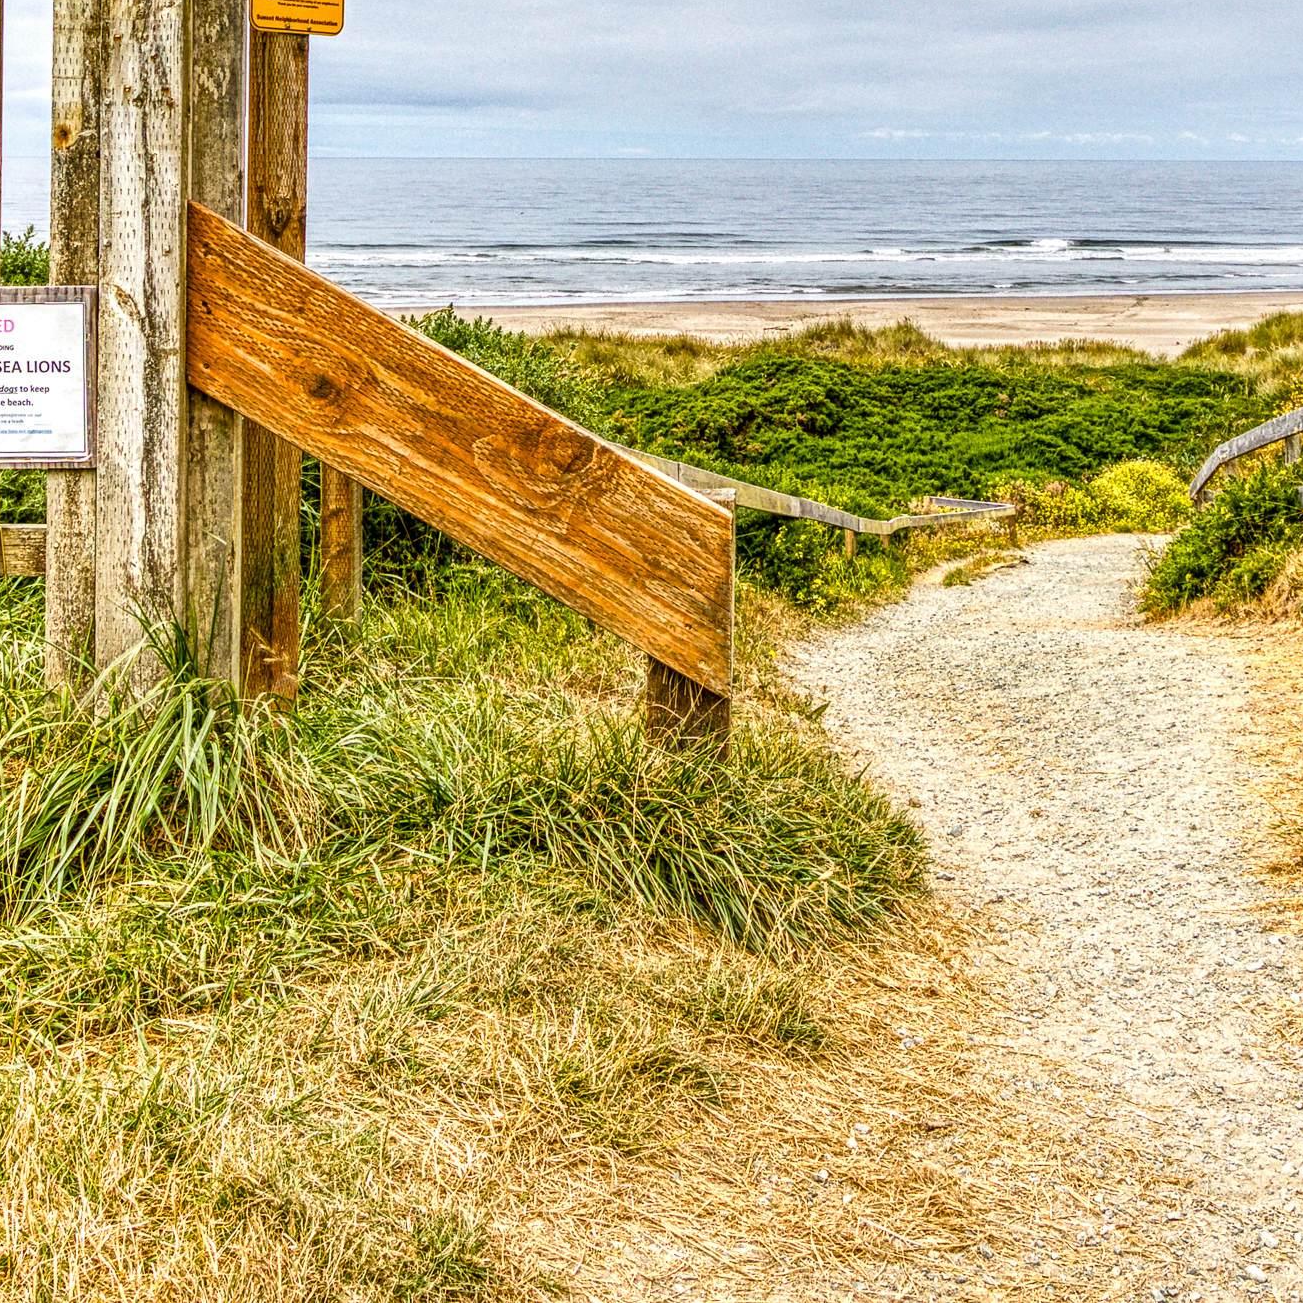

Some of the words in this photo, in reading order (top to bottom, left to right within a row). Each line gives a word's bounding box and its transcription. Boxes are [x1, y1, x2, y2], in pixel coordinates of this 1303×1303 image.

[27, 361, 71, 373] LIONS
[30, 385, 49, 395] keep
[7, 399, 33, 407] beach.
